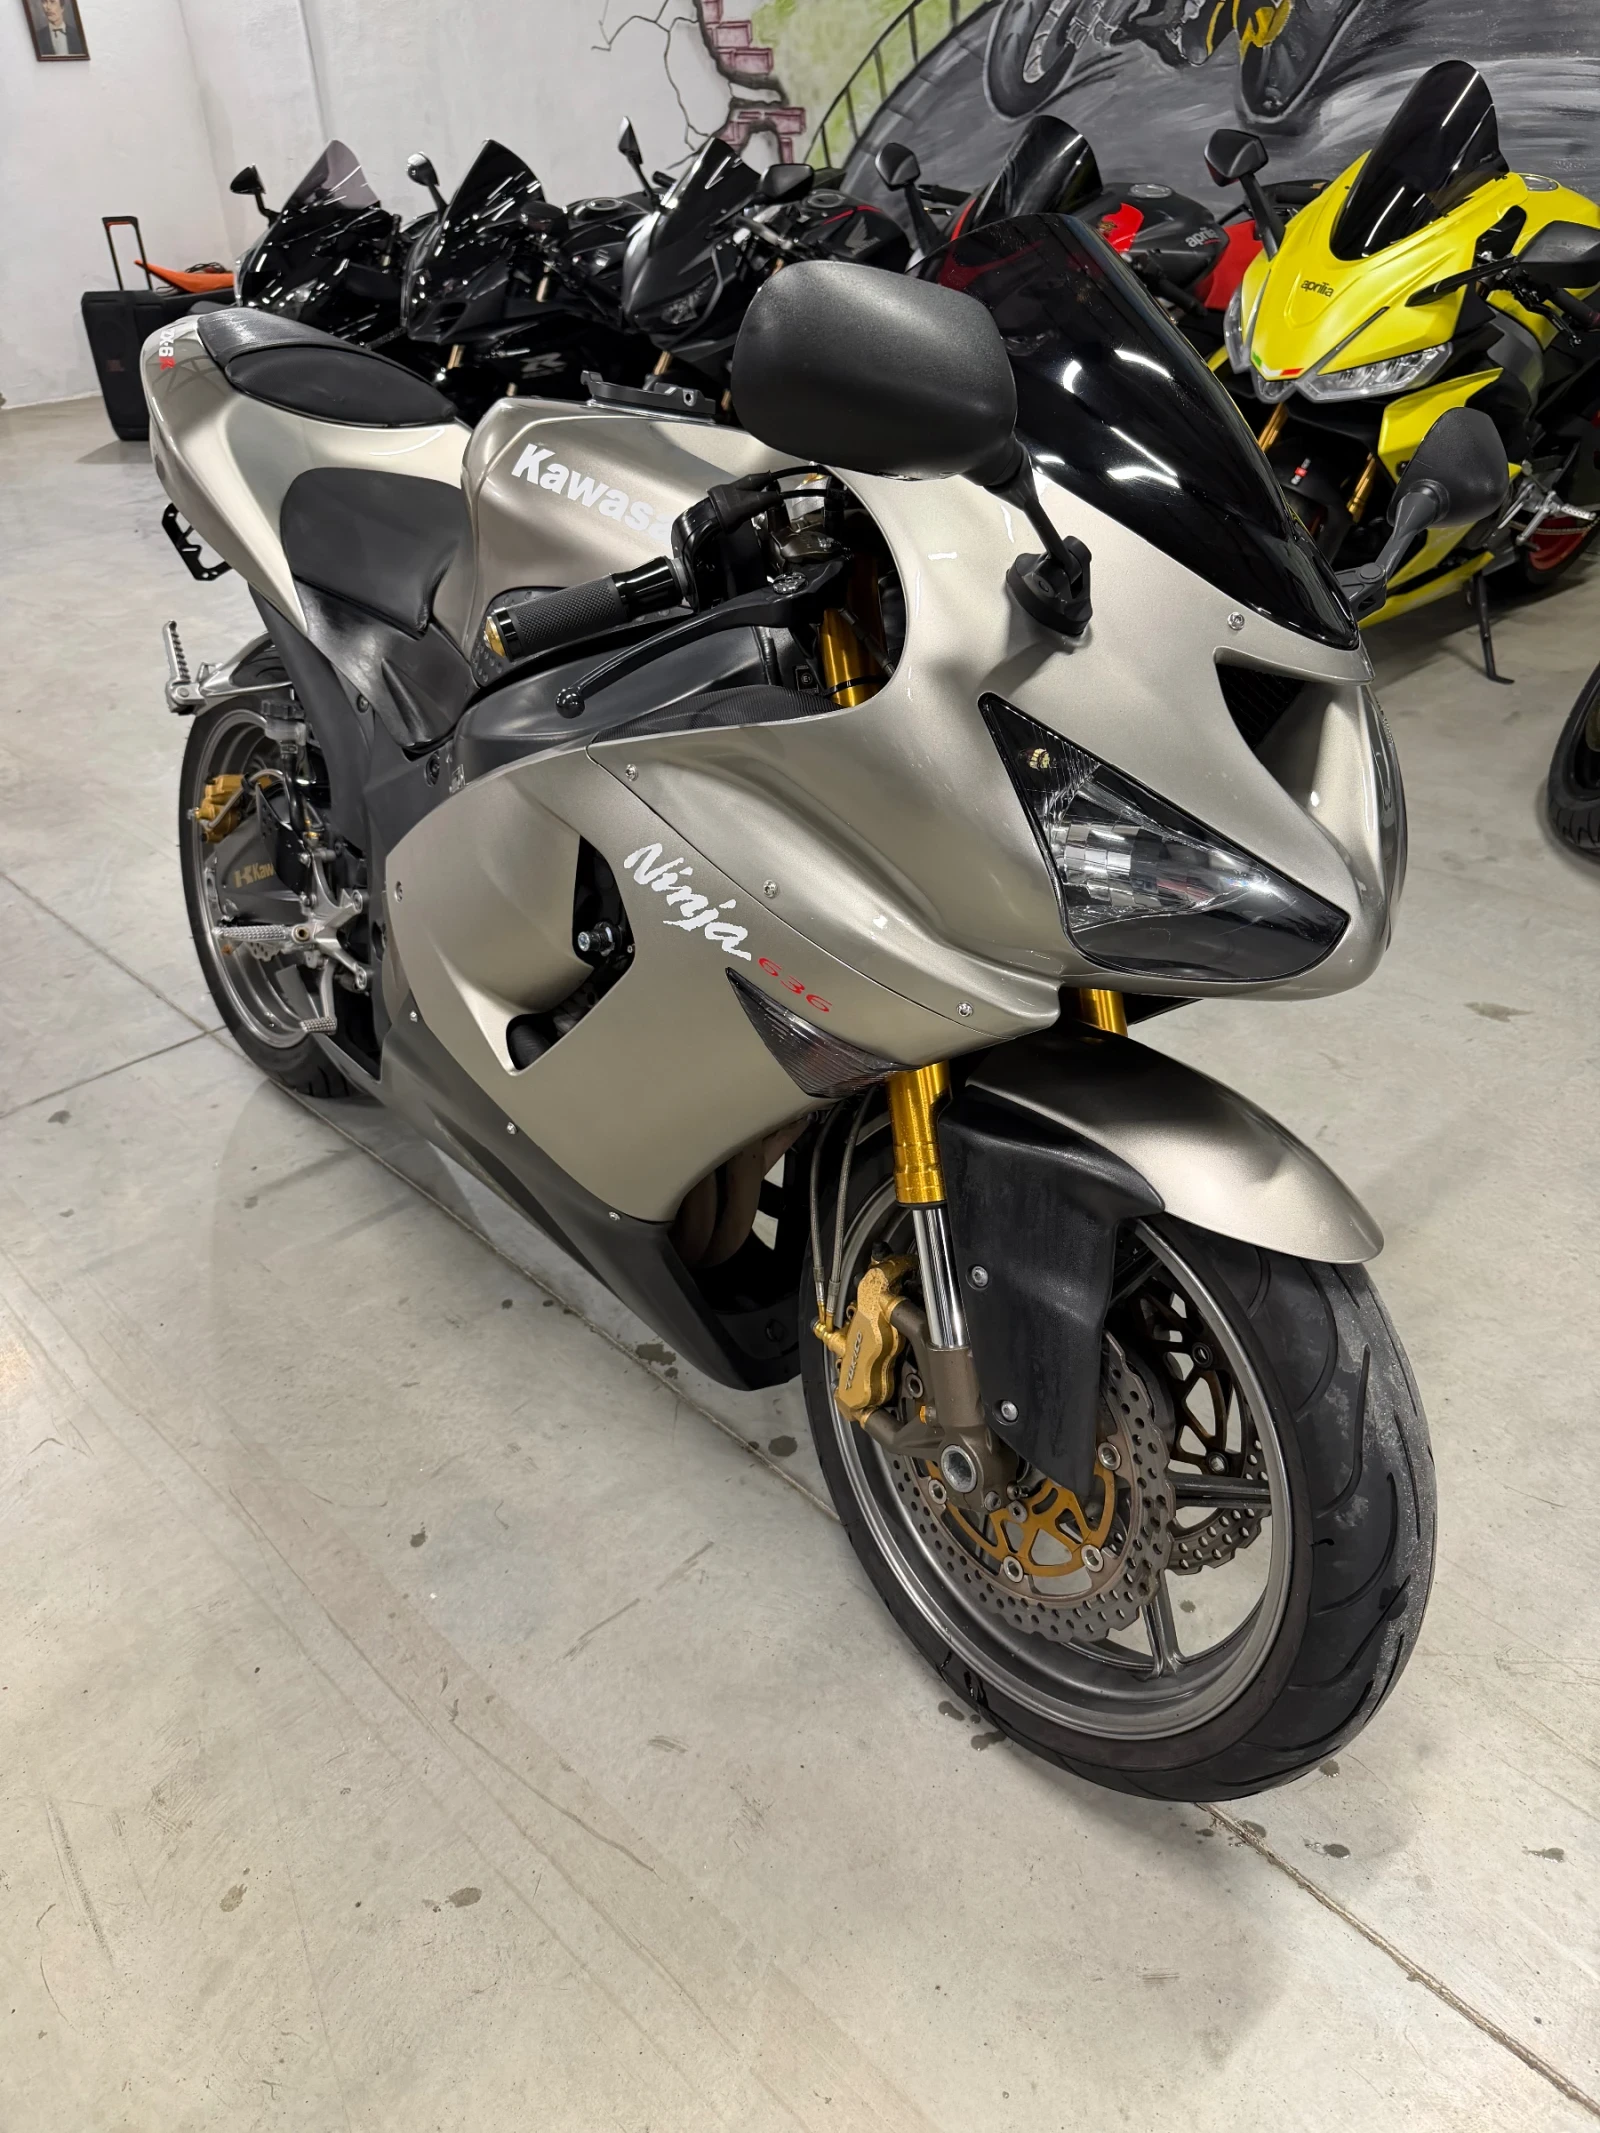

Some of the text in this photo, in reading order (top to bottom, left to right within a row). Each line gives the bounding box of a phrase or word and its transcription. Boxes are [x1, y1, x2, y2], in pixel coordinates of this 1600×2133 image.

[1301, 280, 1334, 298] aprilia
[623, 843, 752, 961] Ninja
[758, 957, 833, 1013] 636
